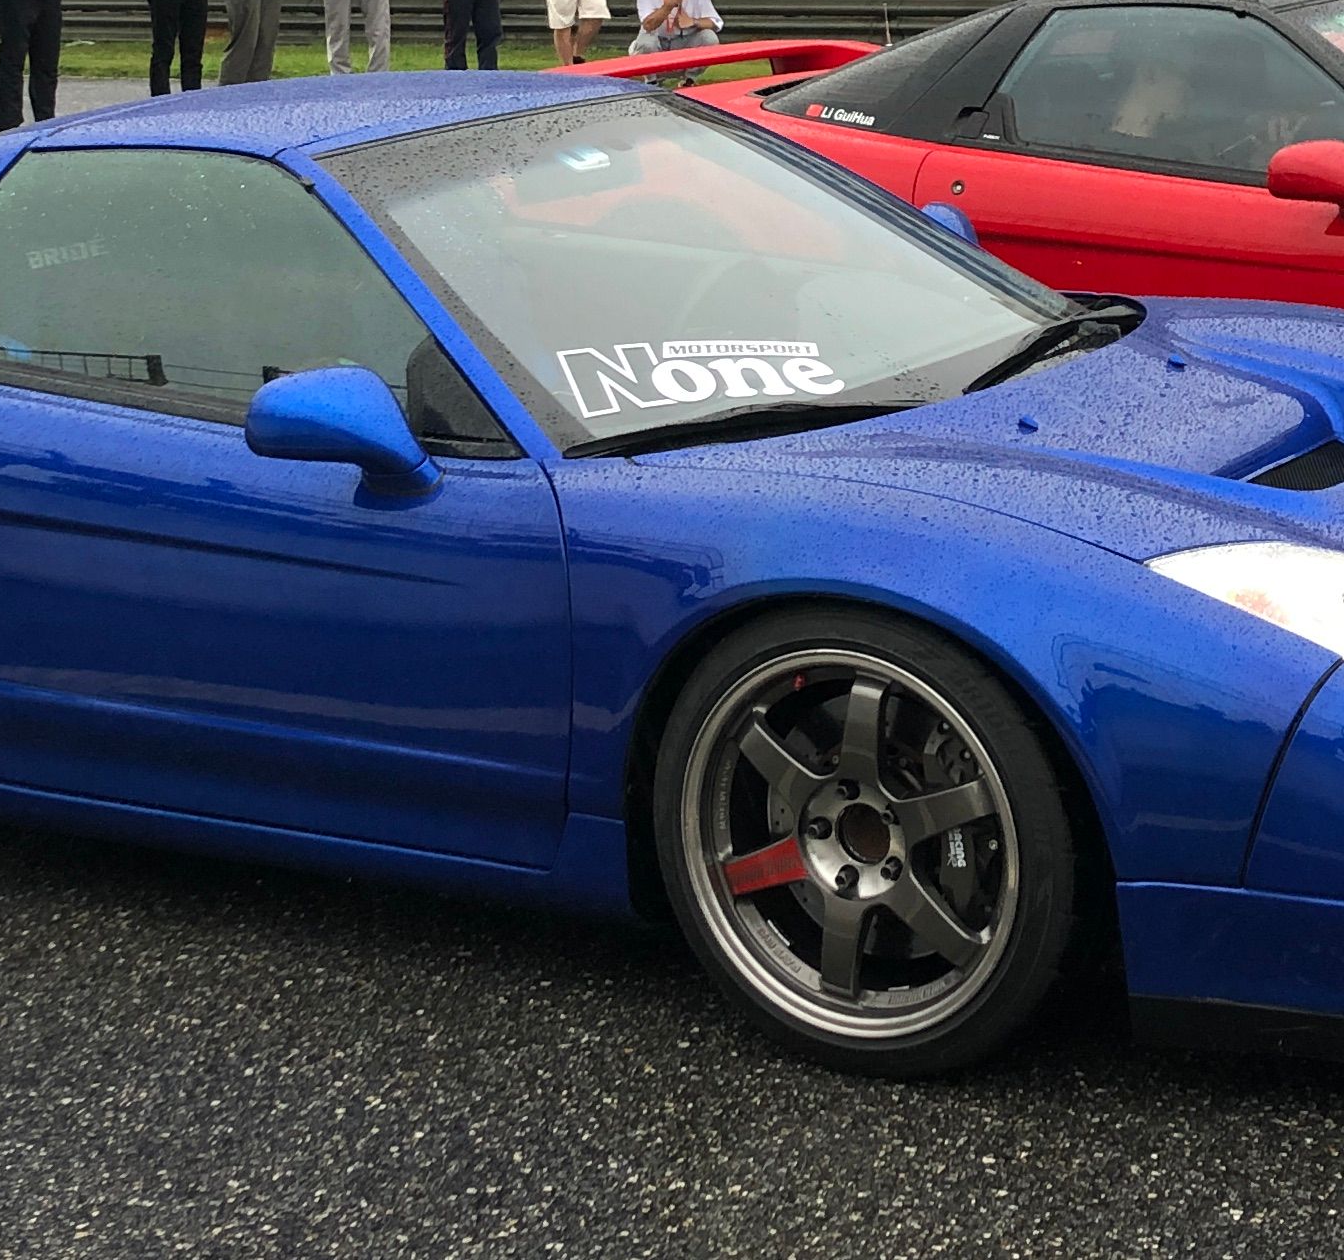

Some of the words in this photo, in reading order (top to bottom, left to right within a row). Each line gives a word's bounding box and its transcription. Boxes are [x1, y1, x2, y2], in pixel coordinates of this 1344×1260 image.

[834, 109, 876, 127] GuiHua
[668, 344, 813, 357] MOTORSPORT
[556, 342, 845, 419] None
